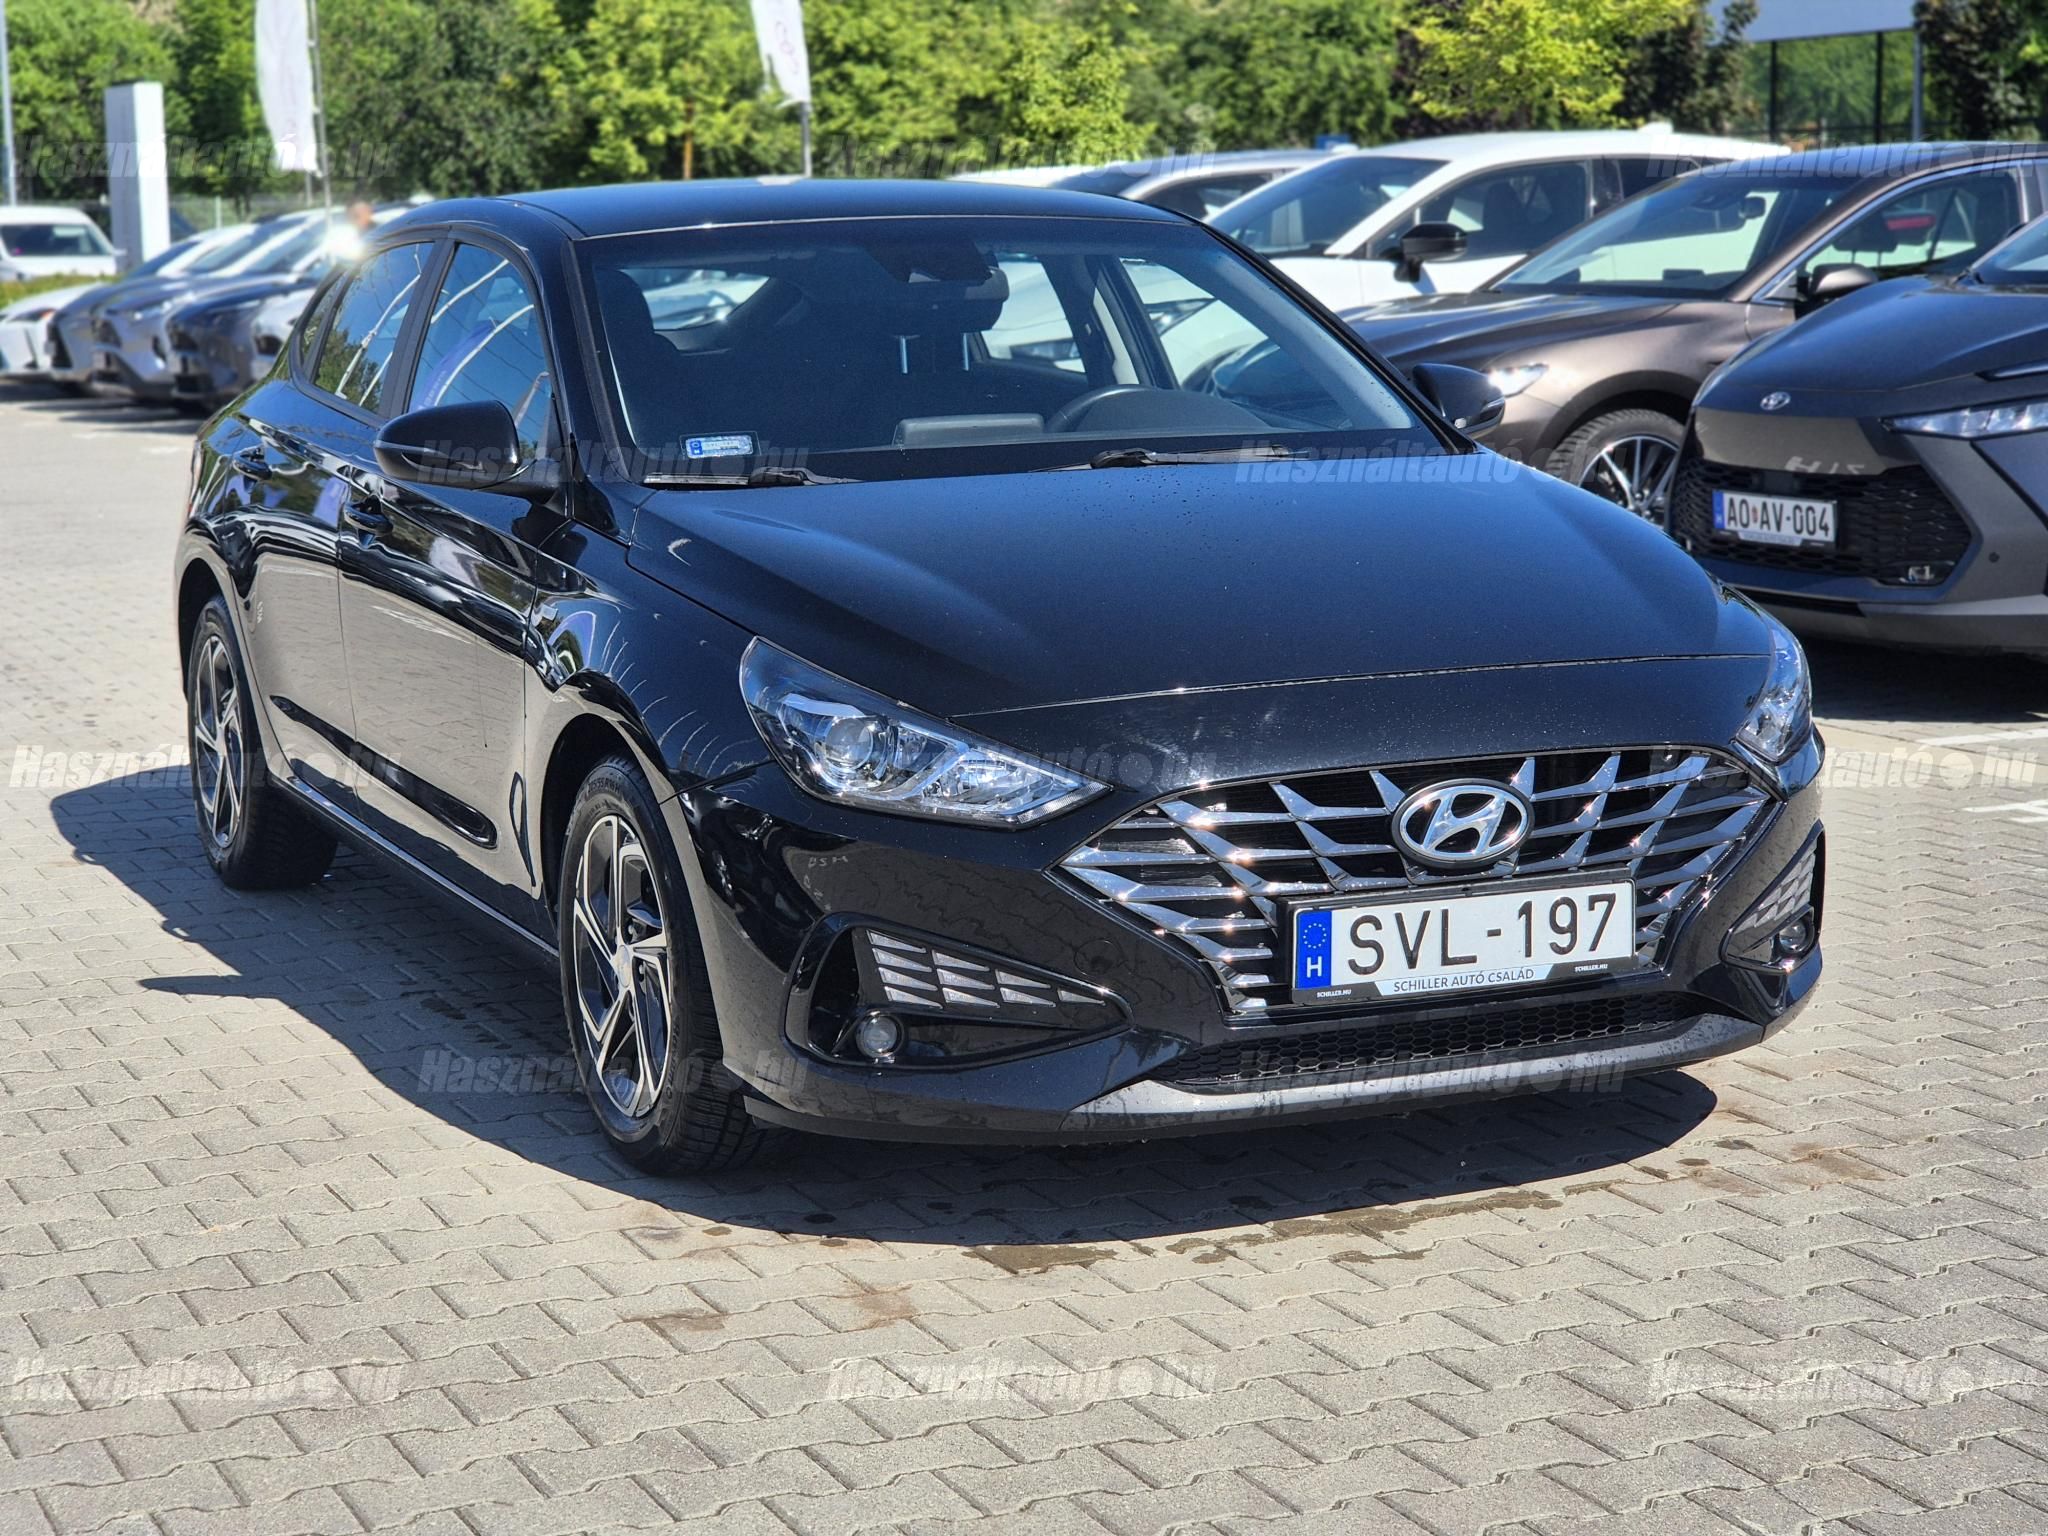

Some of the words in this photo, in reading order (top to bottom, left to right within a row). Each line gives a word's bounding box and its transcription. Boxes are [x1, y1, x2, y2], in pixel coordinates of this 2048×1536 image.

[1305, 955, 1323, 979] H
[1393, 977, 1449, 993] SCHILLER
[1452, 970, 1485, 988] AUTÓ
[1487, 967, 1534, 984] CSALÁD
